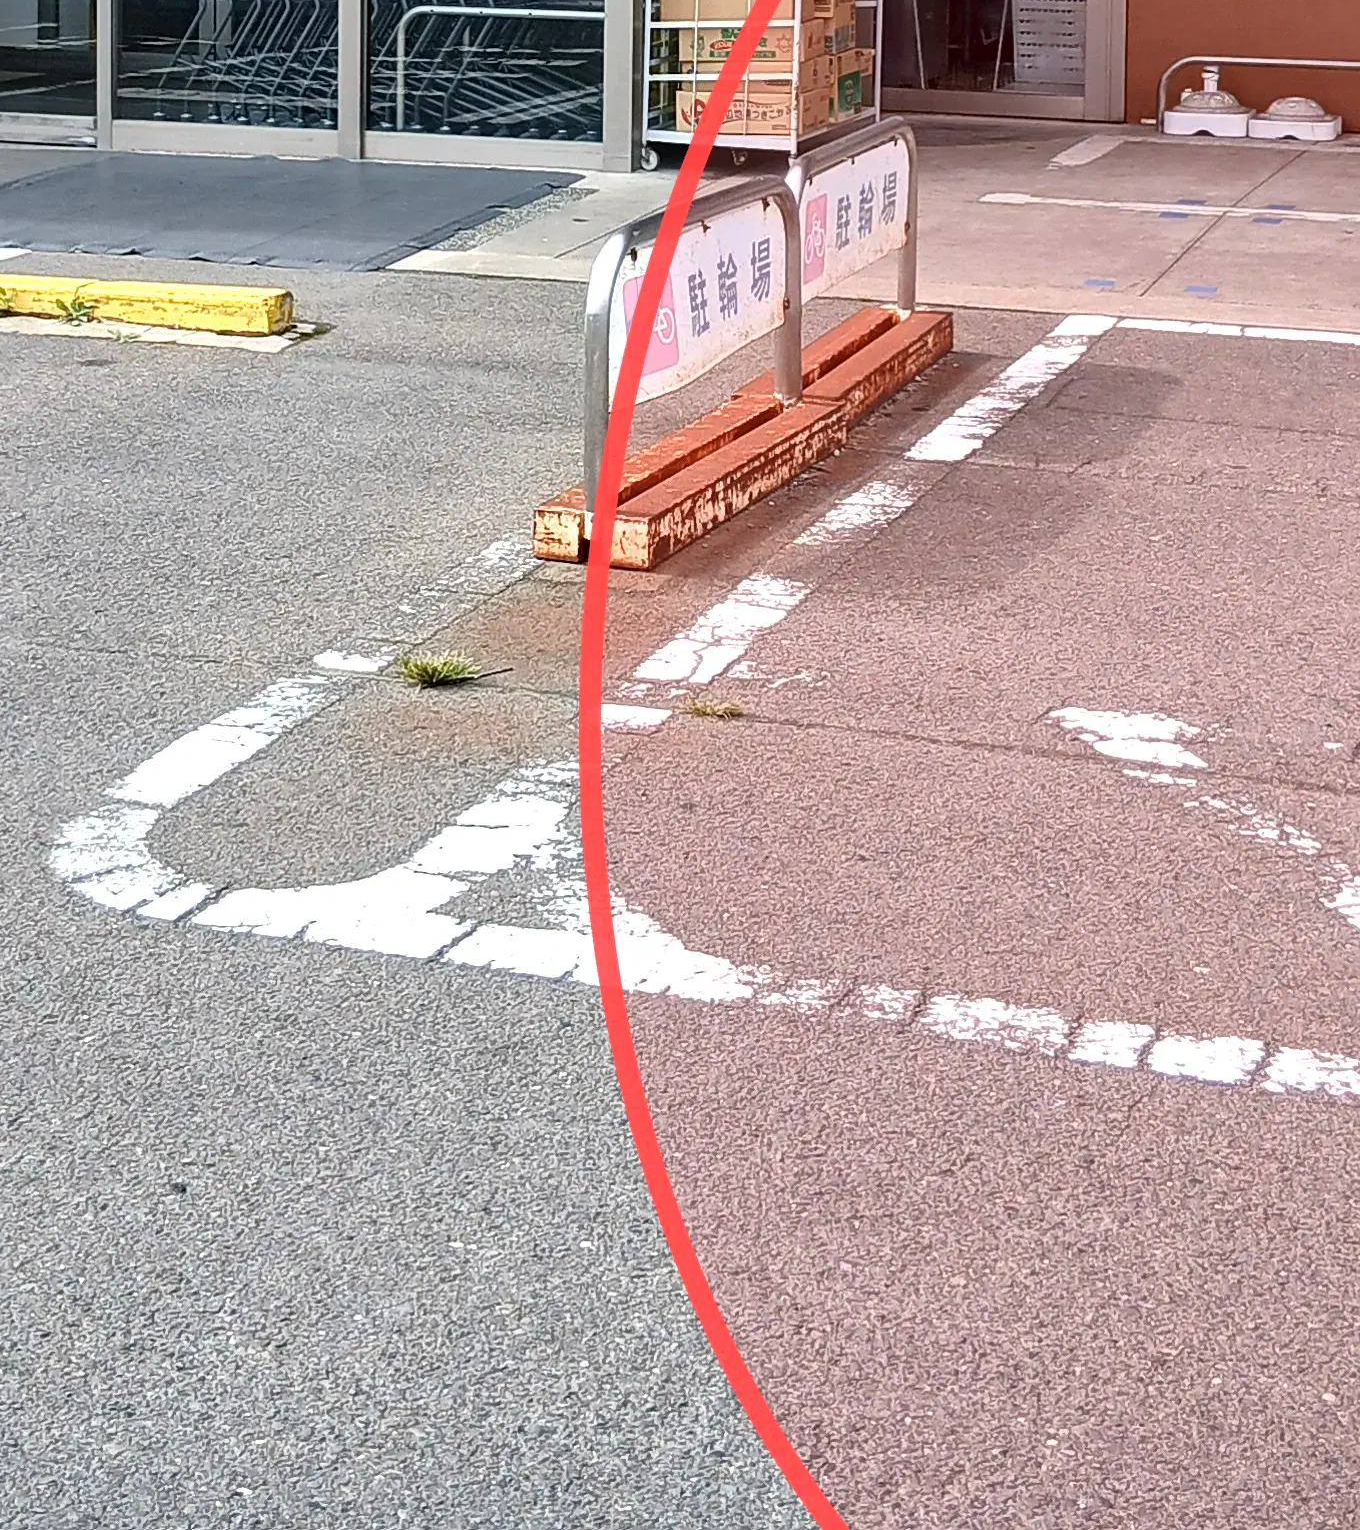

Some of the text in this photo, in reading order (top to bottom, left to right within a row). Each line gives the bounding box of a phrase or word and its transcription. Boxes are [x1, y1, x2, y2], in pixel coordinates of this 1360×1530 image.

[835, 171, 898, 250] 駐輪場
[687, 237, 773, 337] 駐輪場
